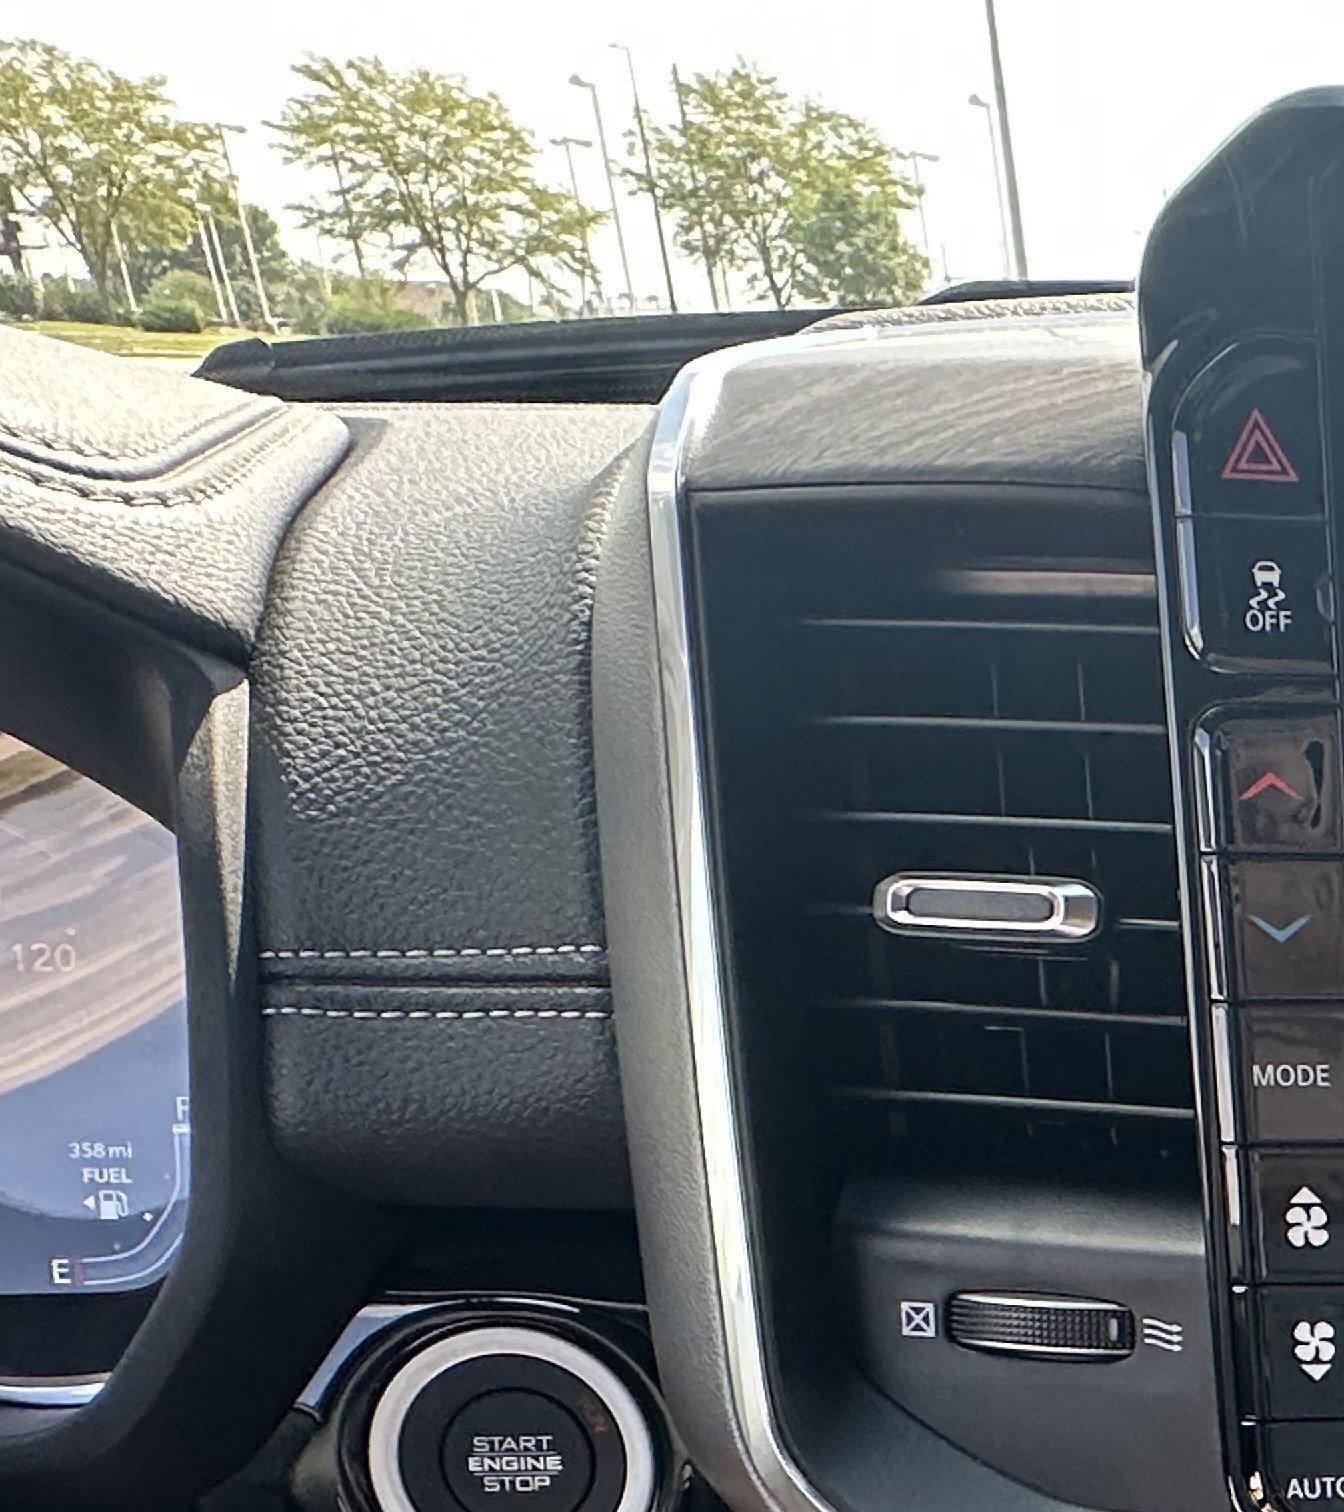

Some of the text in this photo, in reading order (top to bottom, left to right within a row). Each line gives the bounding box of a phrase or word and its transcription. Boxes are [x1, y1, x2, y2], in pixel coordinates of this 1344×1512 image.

[1245, 609, 1292, 633] OFF
[11, 943, 76, 973] 120
[1252, 1064, 1331, 1088] MODE
[82, 1167, 133, 1184] FUEL
[51, 1258, 72, 1284] E
[472, 1435, 553, 1452] START
[467, 1456, 564, 1472] ENGINE
[483, 1476, 551, 1492] STOP
